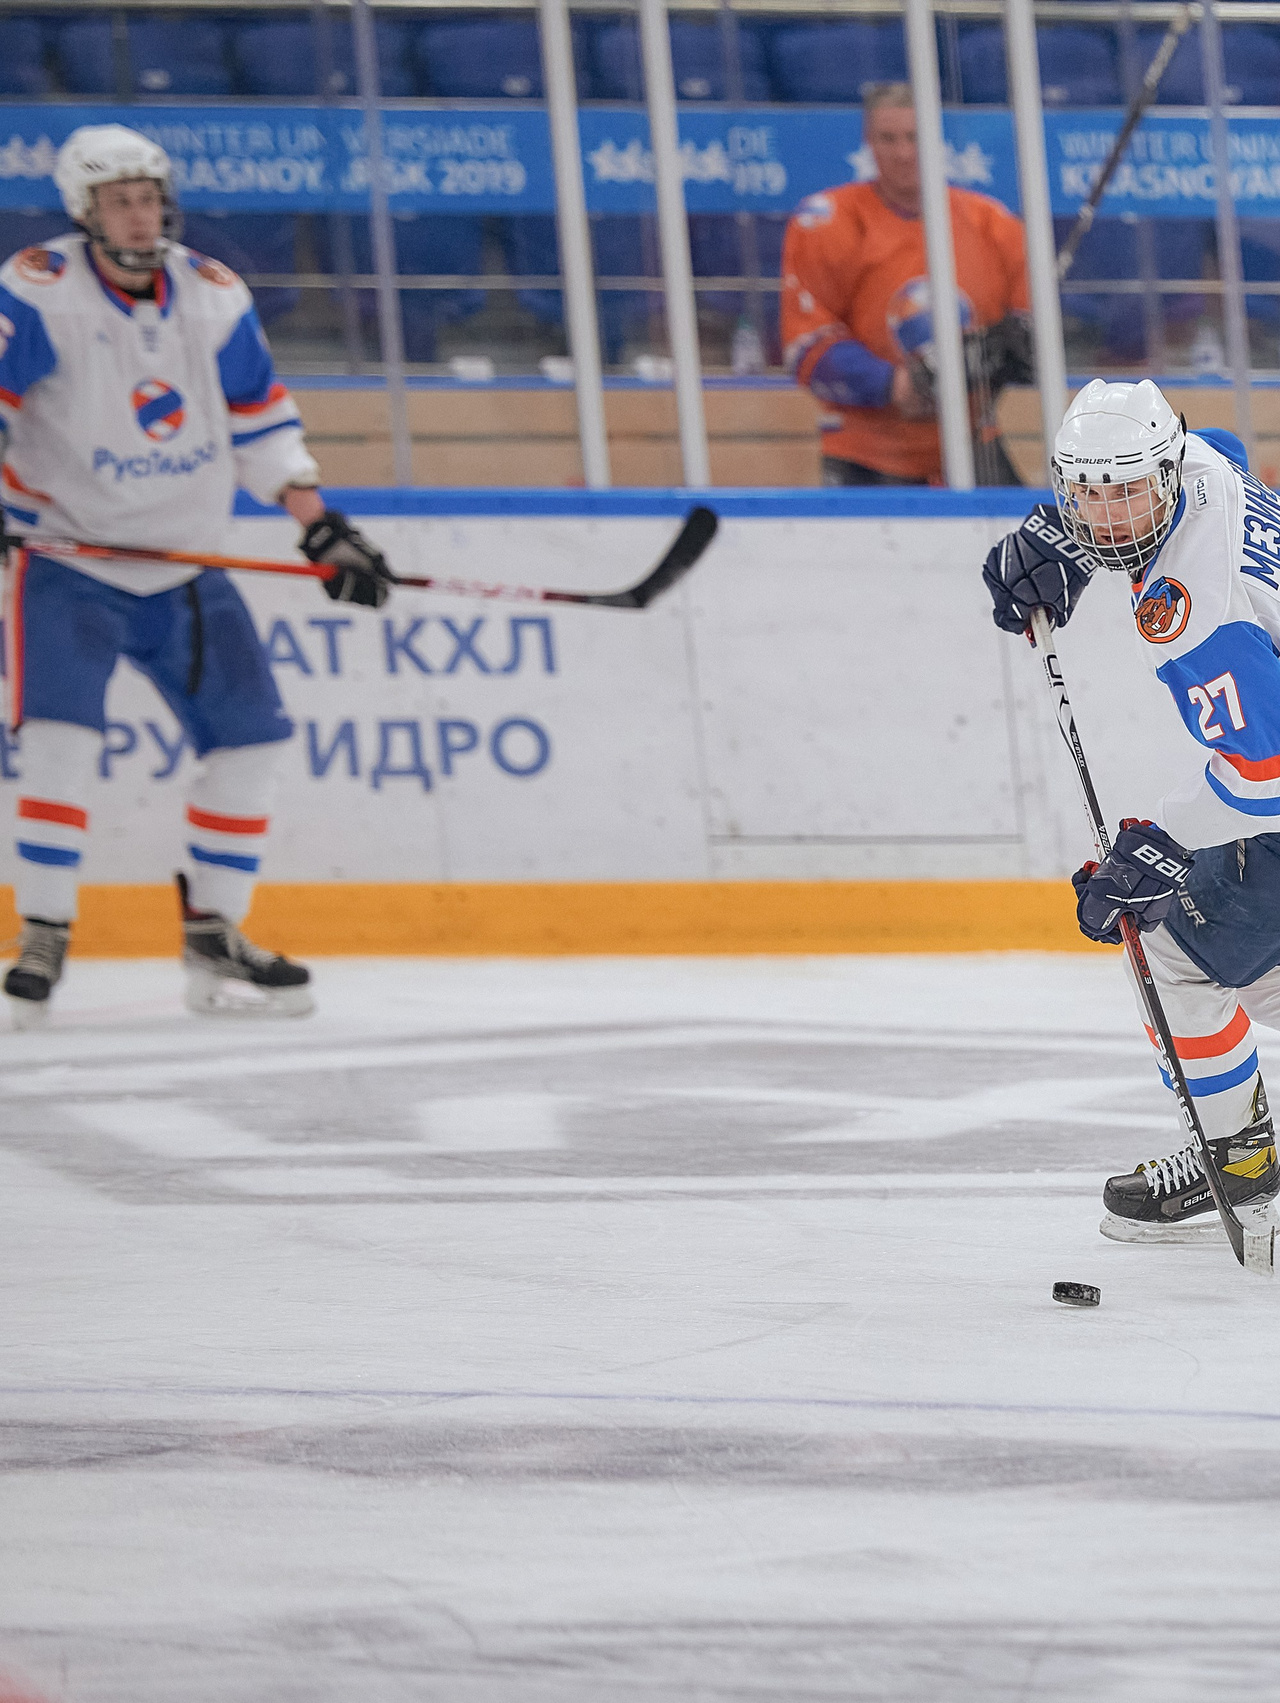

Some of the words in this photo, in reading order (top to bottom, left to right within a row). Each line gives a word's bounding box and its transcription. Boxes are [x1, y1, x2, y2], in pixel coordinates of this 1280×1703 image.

[1074, 457, 1113, 466] BAUER
[267, 618, 353, 675] АТ
[384, 618, 558, 675] КХЛ
[1187, 671, 1248, 741] 27
[1131, 843, 1191, 883] BAU
[1129, 928, 1147, 970] VAPOR
[1183, 1189, 1214, 1208] BAUE
